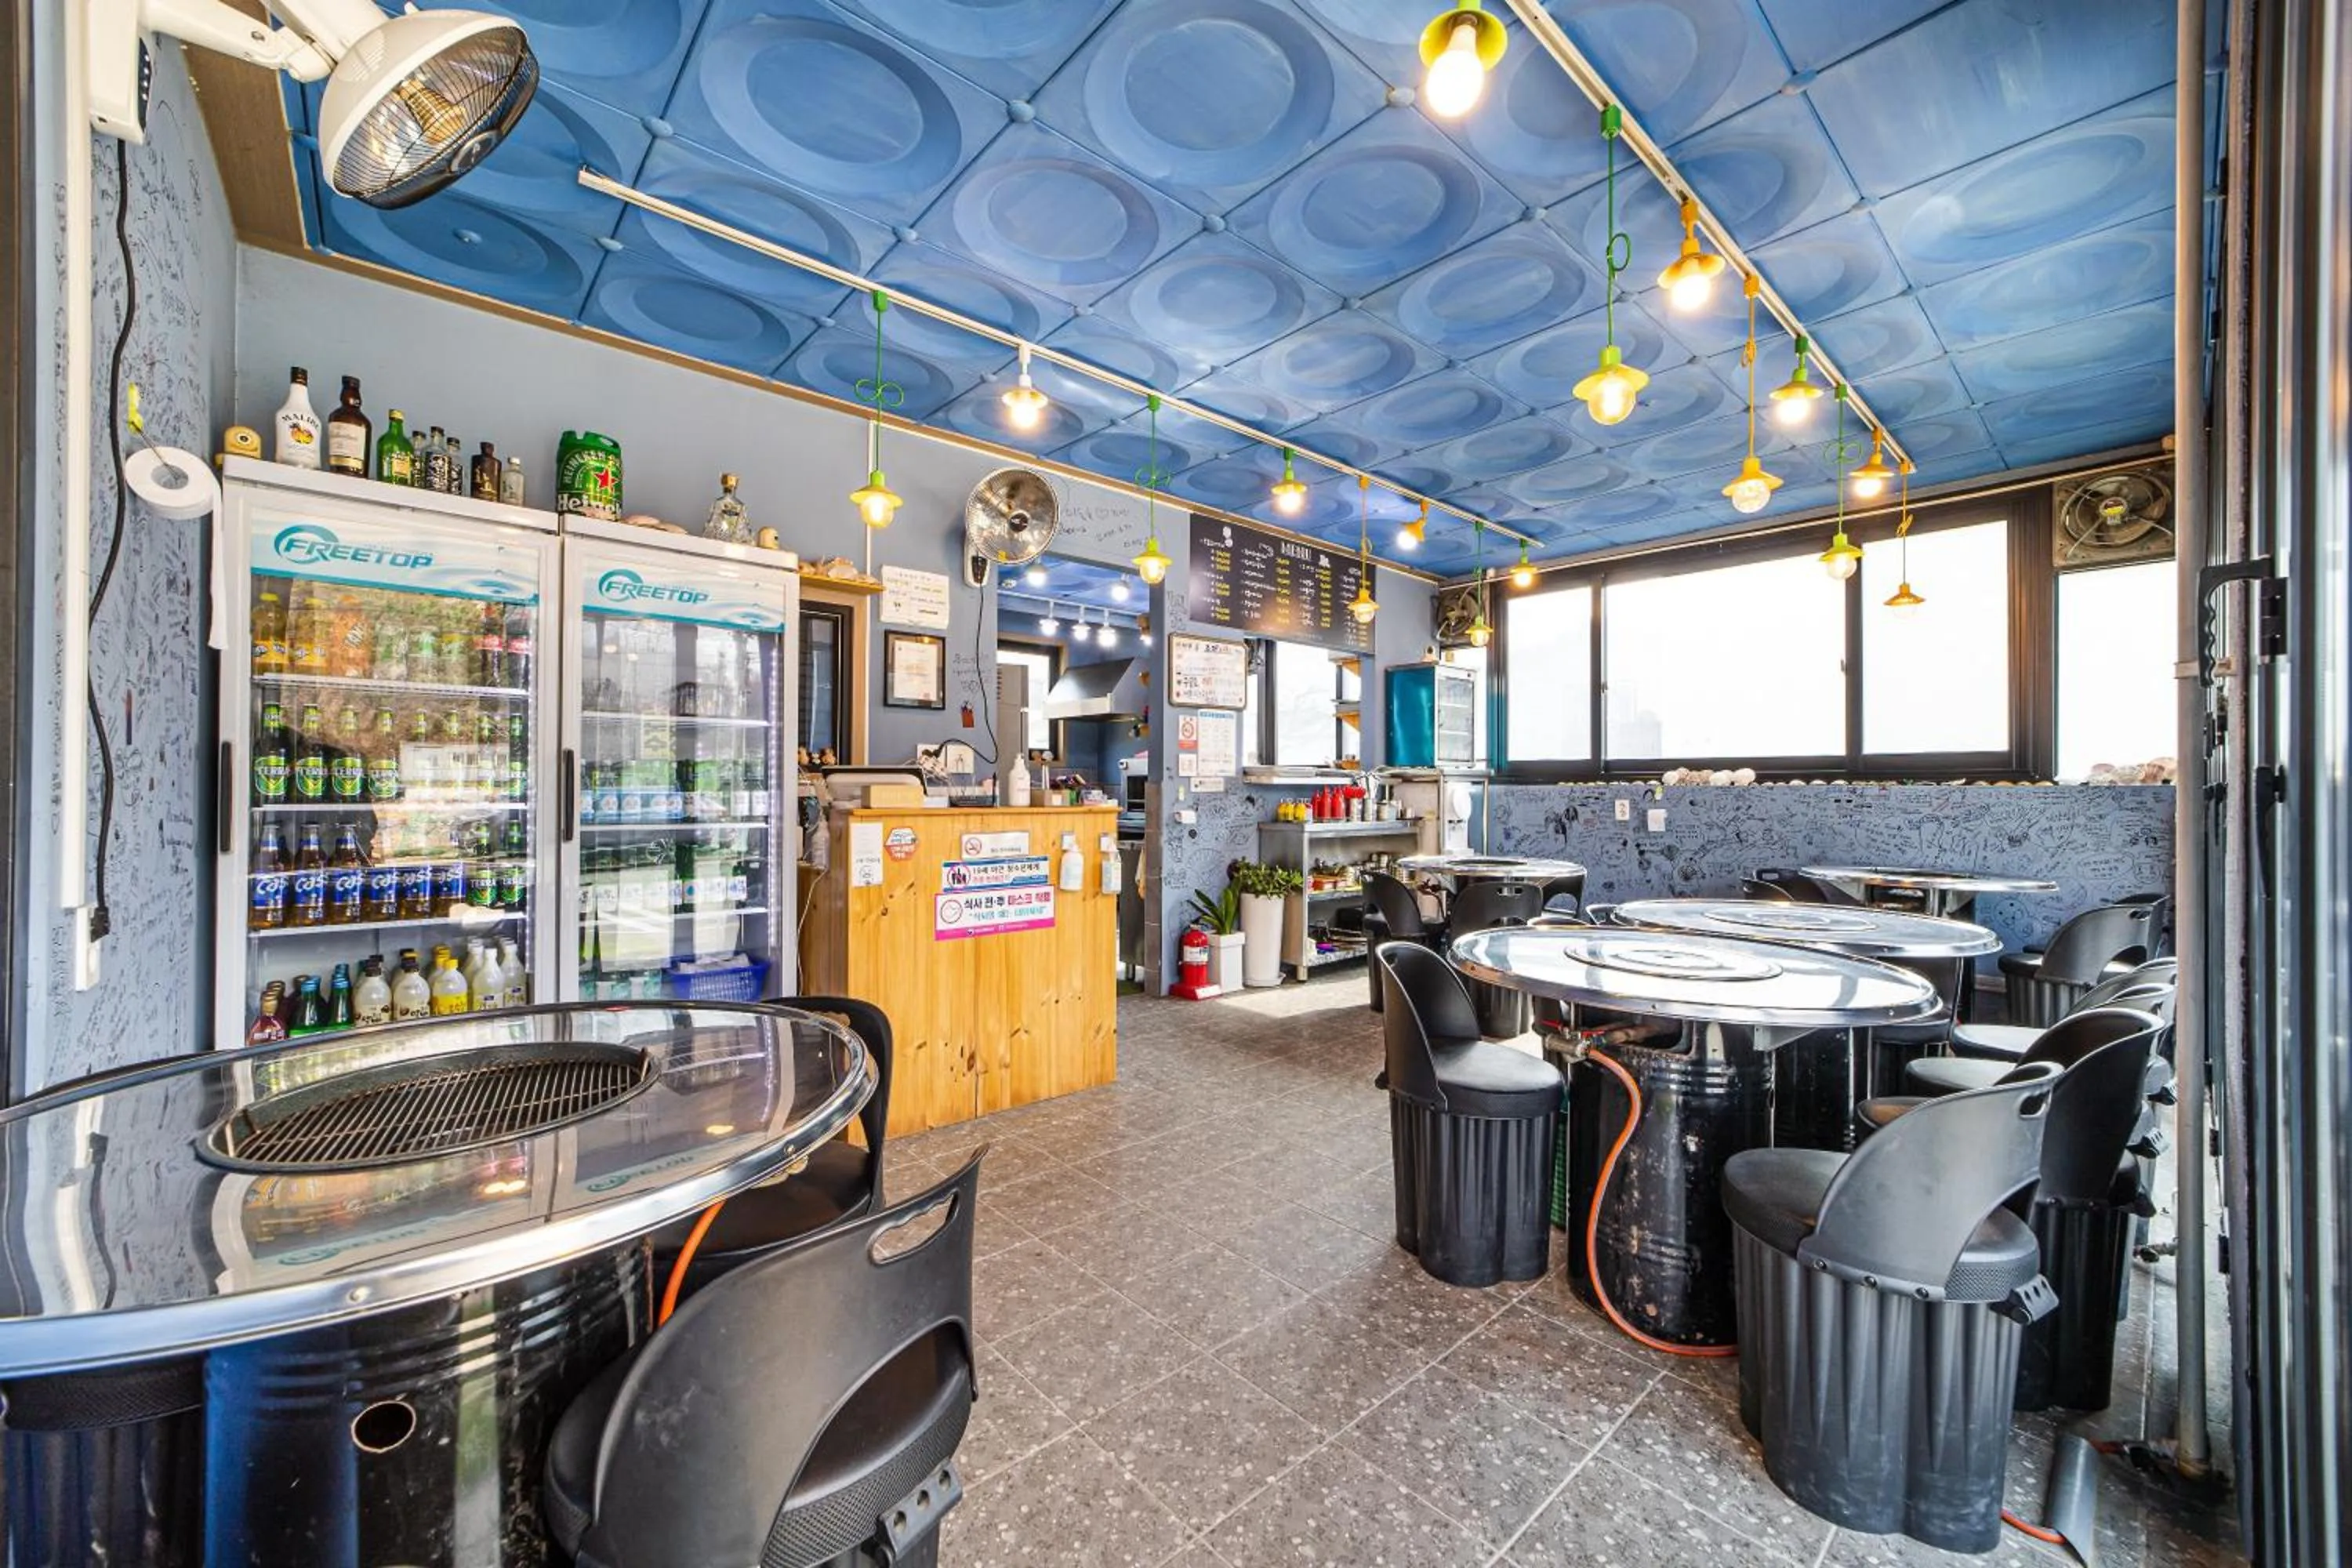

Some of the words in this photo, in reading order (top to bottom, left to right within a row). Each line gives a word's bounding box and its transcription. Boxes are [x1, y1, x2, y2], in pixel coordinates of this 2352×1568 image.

[285, 537, 435, 569] FREETOP
[1280, 541, 1312, 560] MENU
[604, 581, 710, 604] FREETOP
